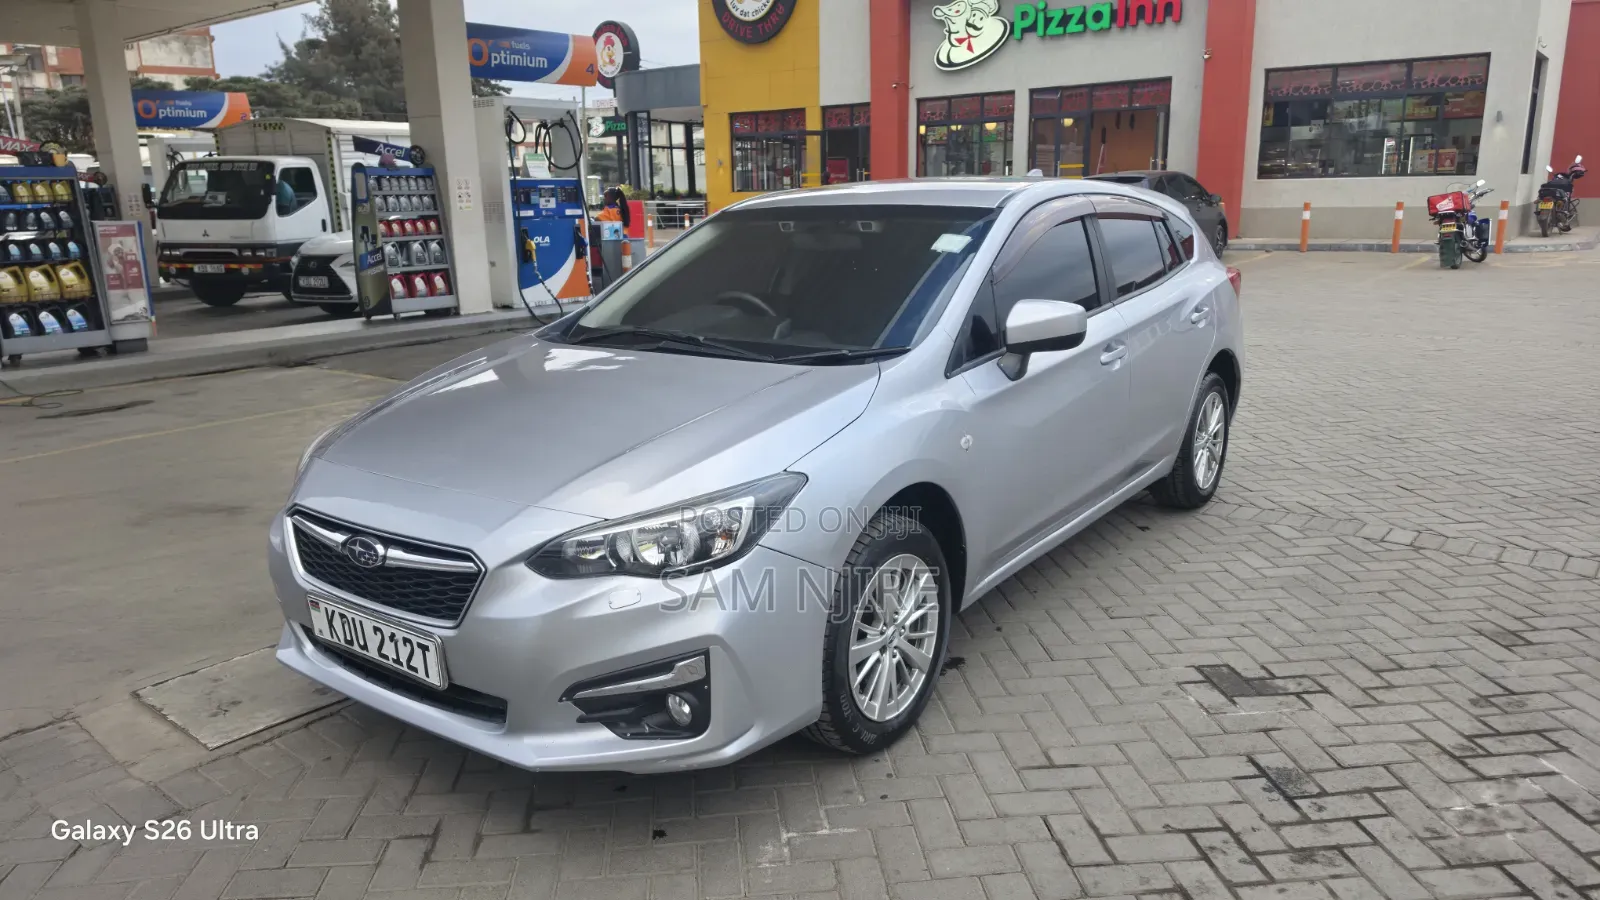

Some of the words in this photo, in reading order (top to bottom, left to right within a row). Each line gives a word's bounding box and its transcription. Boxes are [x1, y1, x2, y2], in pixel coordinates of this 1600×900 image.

[740, 9, 750, 17] dat
[1013, 0, 1113, 40] Pizza
[1115, 0, 1183, 28] Inn
[722, 12, 753, 39] DRIVE
[757, 4, 785, 36] THRU
[467, 38, 548, 69] Optimium
[586, 63, 595, 75] 4
[137, 99, 207, 119] Optimium
[605, 120, 627, 131] Pizza
[375, 143, 406, 158] Accel
[533, 236, 550, 244] OLA
[367, 252, 382, 265] Accel
[325, 607, 370, 653] KDU
[372, 625, 431, 679] 212T
